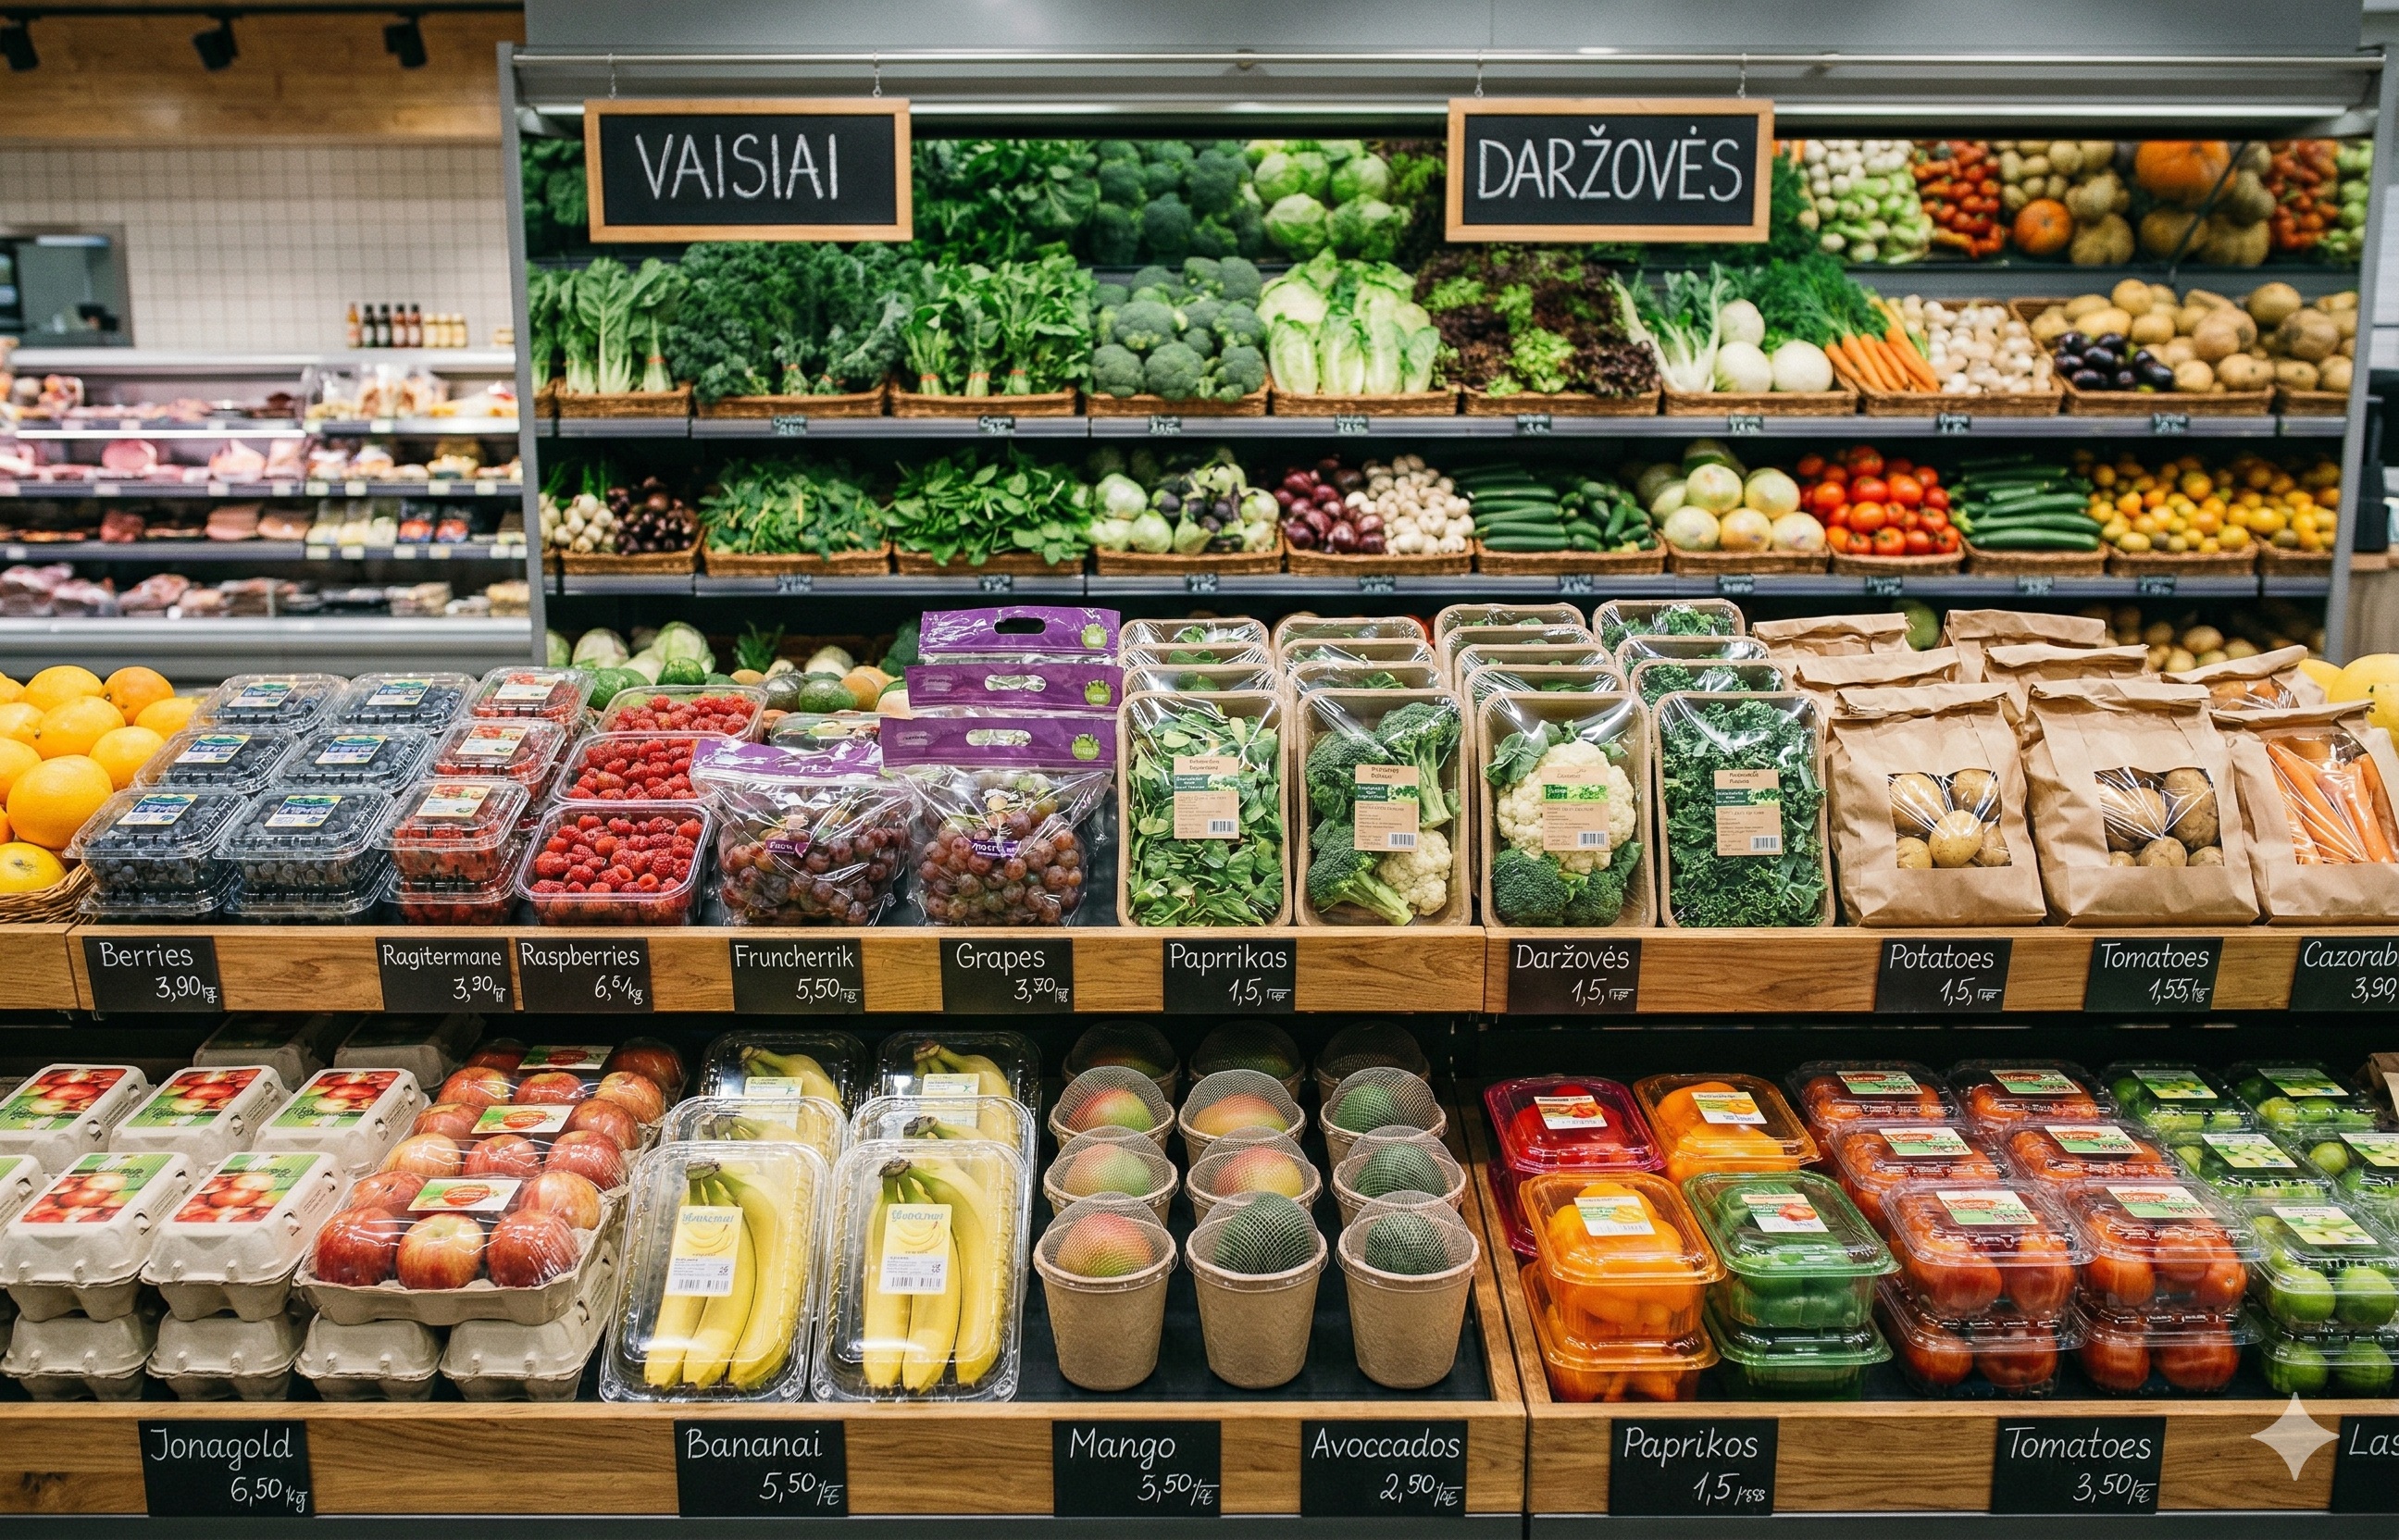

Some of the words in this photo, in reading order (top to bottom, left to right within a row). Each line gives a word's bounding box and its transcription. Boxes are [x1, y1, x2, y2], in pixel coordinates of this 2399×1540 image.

[635, 130, 841, 200] VAISIAI
[1477, 125, 1744, 203] DARŽOVĖS
[99, 941, 194, 967] Berries
[382, 944, 503, 971] Ragitermane
[520, 942, 640, 973] Raspberries
[734, 944, 854, 968] Fruncherrik
[956, 942, 1047, 976] Grapes
[1889, 943, 1995, 969] Potatoes
[2101, 942, 2209, 969] Tomatoes
[2304, 940, 2399, 967] Cazorab
[150, 1427, 293, 1472] Jonagold
[685, 1427, 823, 1459] Bananai
[1070, 1427, 1176, 1471] Mango
[1311, 1427, 1461, 1459] Avoccados
[1623, 1426, 1759, 1468] Paprikos
[2005, 1426, 2153, 1459] Tomatoes
[230, 1476, 282, 1508] 6,50
